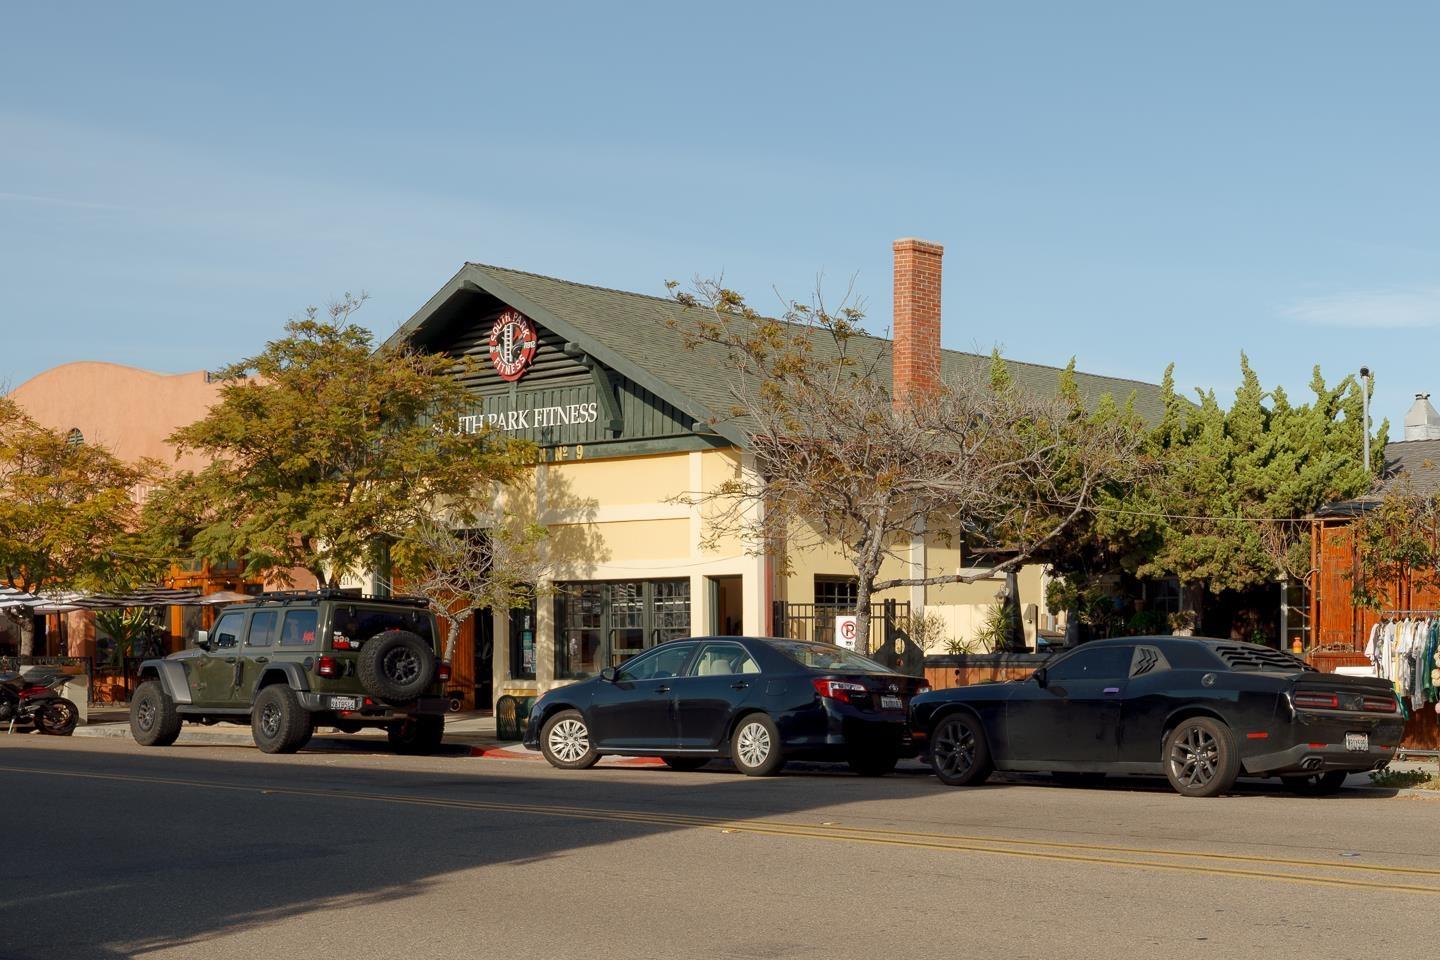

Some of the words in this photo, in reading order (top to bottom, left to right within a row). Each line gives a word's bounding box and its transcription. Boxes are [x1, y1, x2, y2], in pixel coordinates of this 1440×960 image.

[491, 312, 511, 341] SOUTH
[513, 312, 530, 338] PARK
[493, 354, 526, 375] FITNESS
[488, 410, 530, 431] PARK
[533, 403, 598, 428] FITNESS
[576, 445, 584, 460] 9
